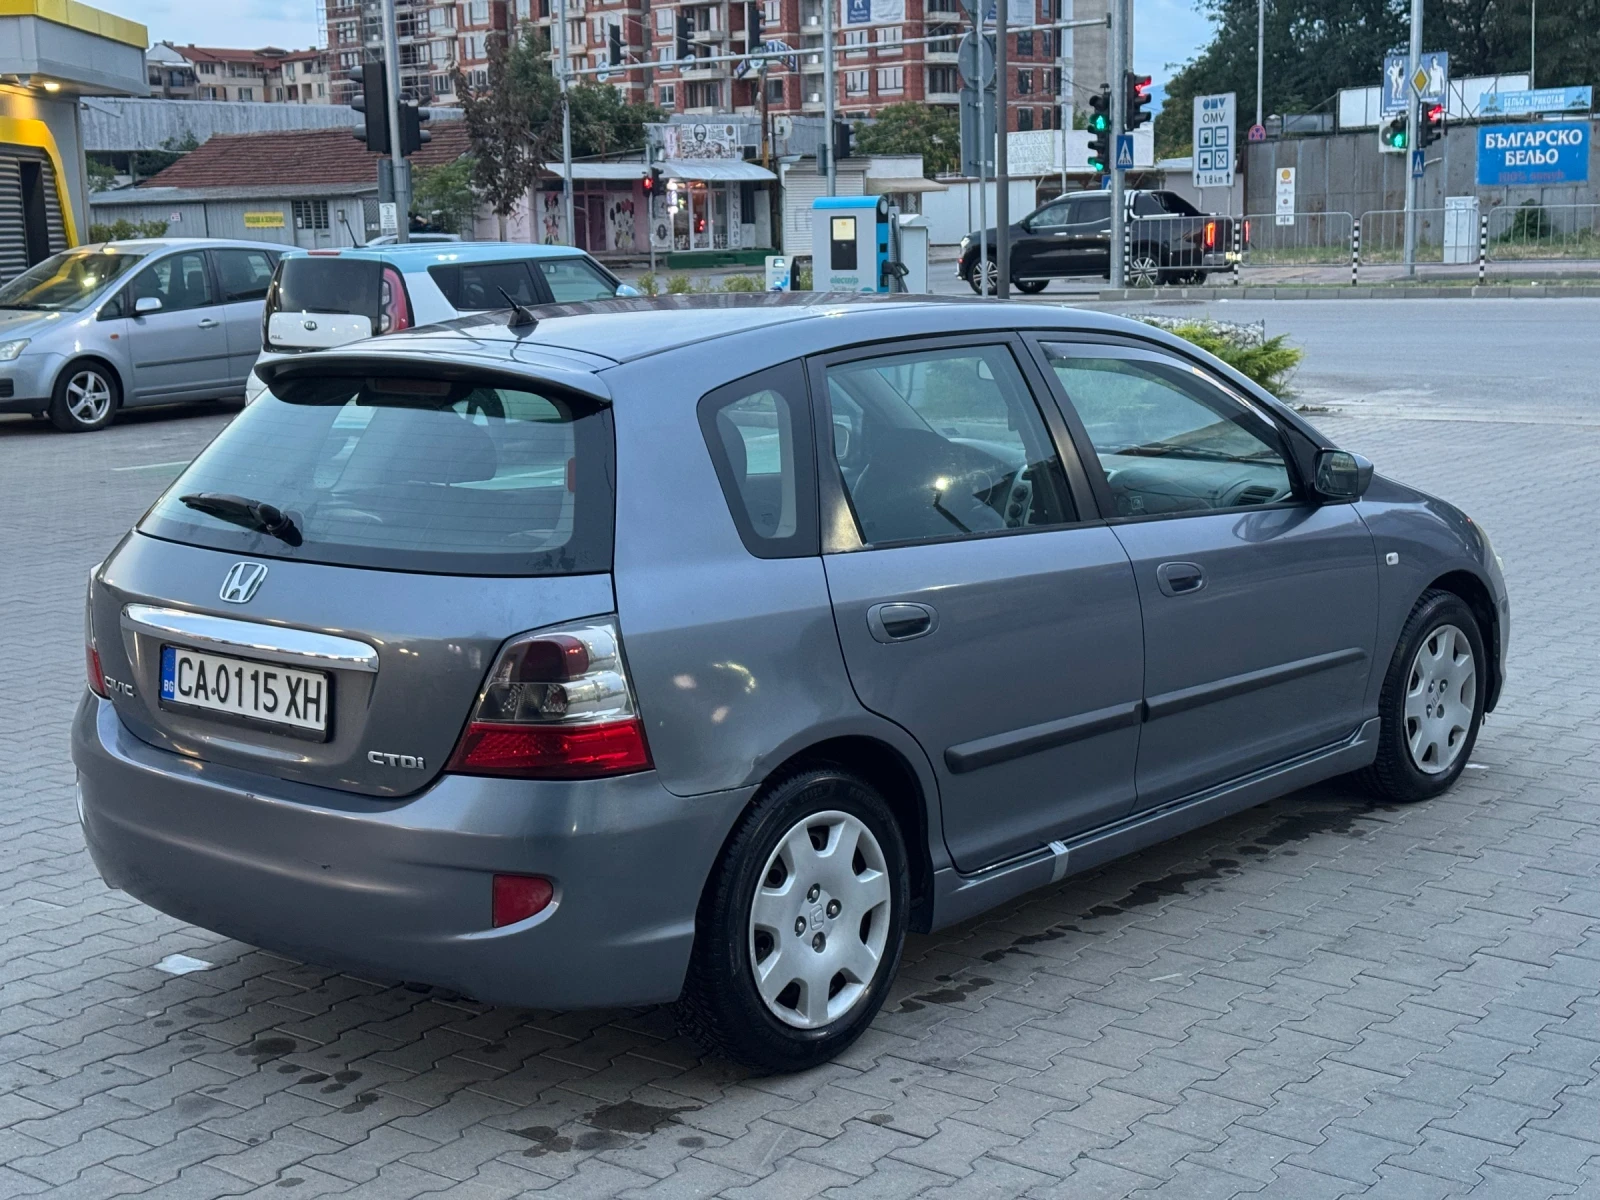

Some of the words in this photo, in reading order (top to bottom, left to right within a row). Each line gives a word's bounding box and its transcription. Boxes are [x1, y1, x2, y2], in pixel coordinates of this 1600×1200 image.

[1203, 97, 1226, 110] OMV
[1202, 112, 1226, 124] OMV
[1485, 129, 1583, 149] БЪЛГАРСКО
[1505, 148, 1559, 167] БЕЛЬО
[305, 321, 316, 329] KIA
[104, 675, 134, 697] CIVIC
[164, 679, 175, 693] BG
[367, 750, 425, 770] CTDi
